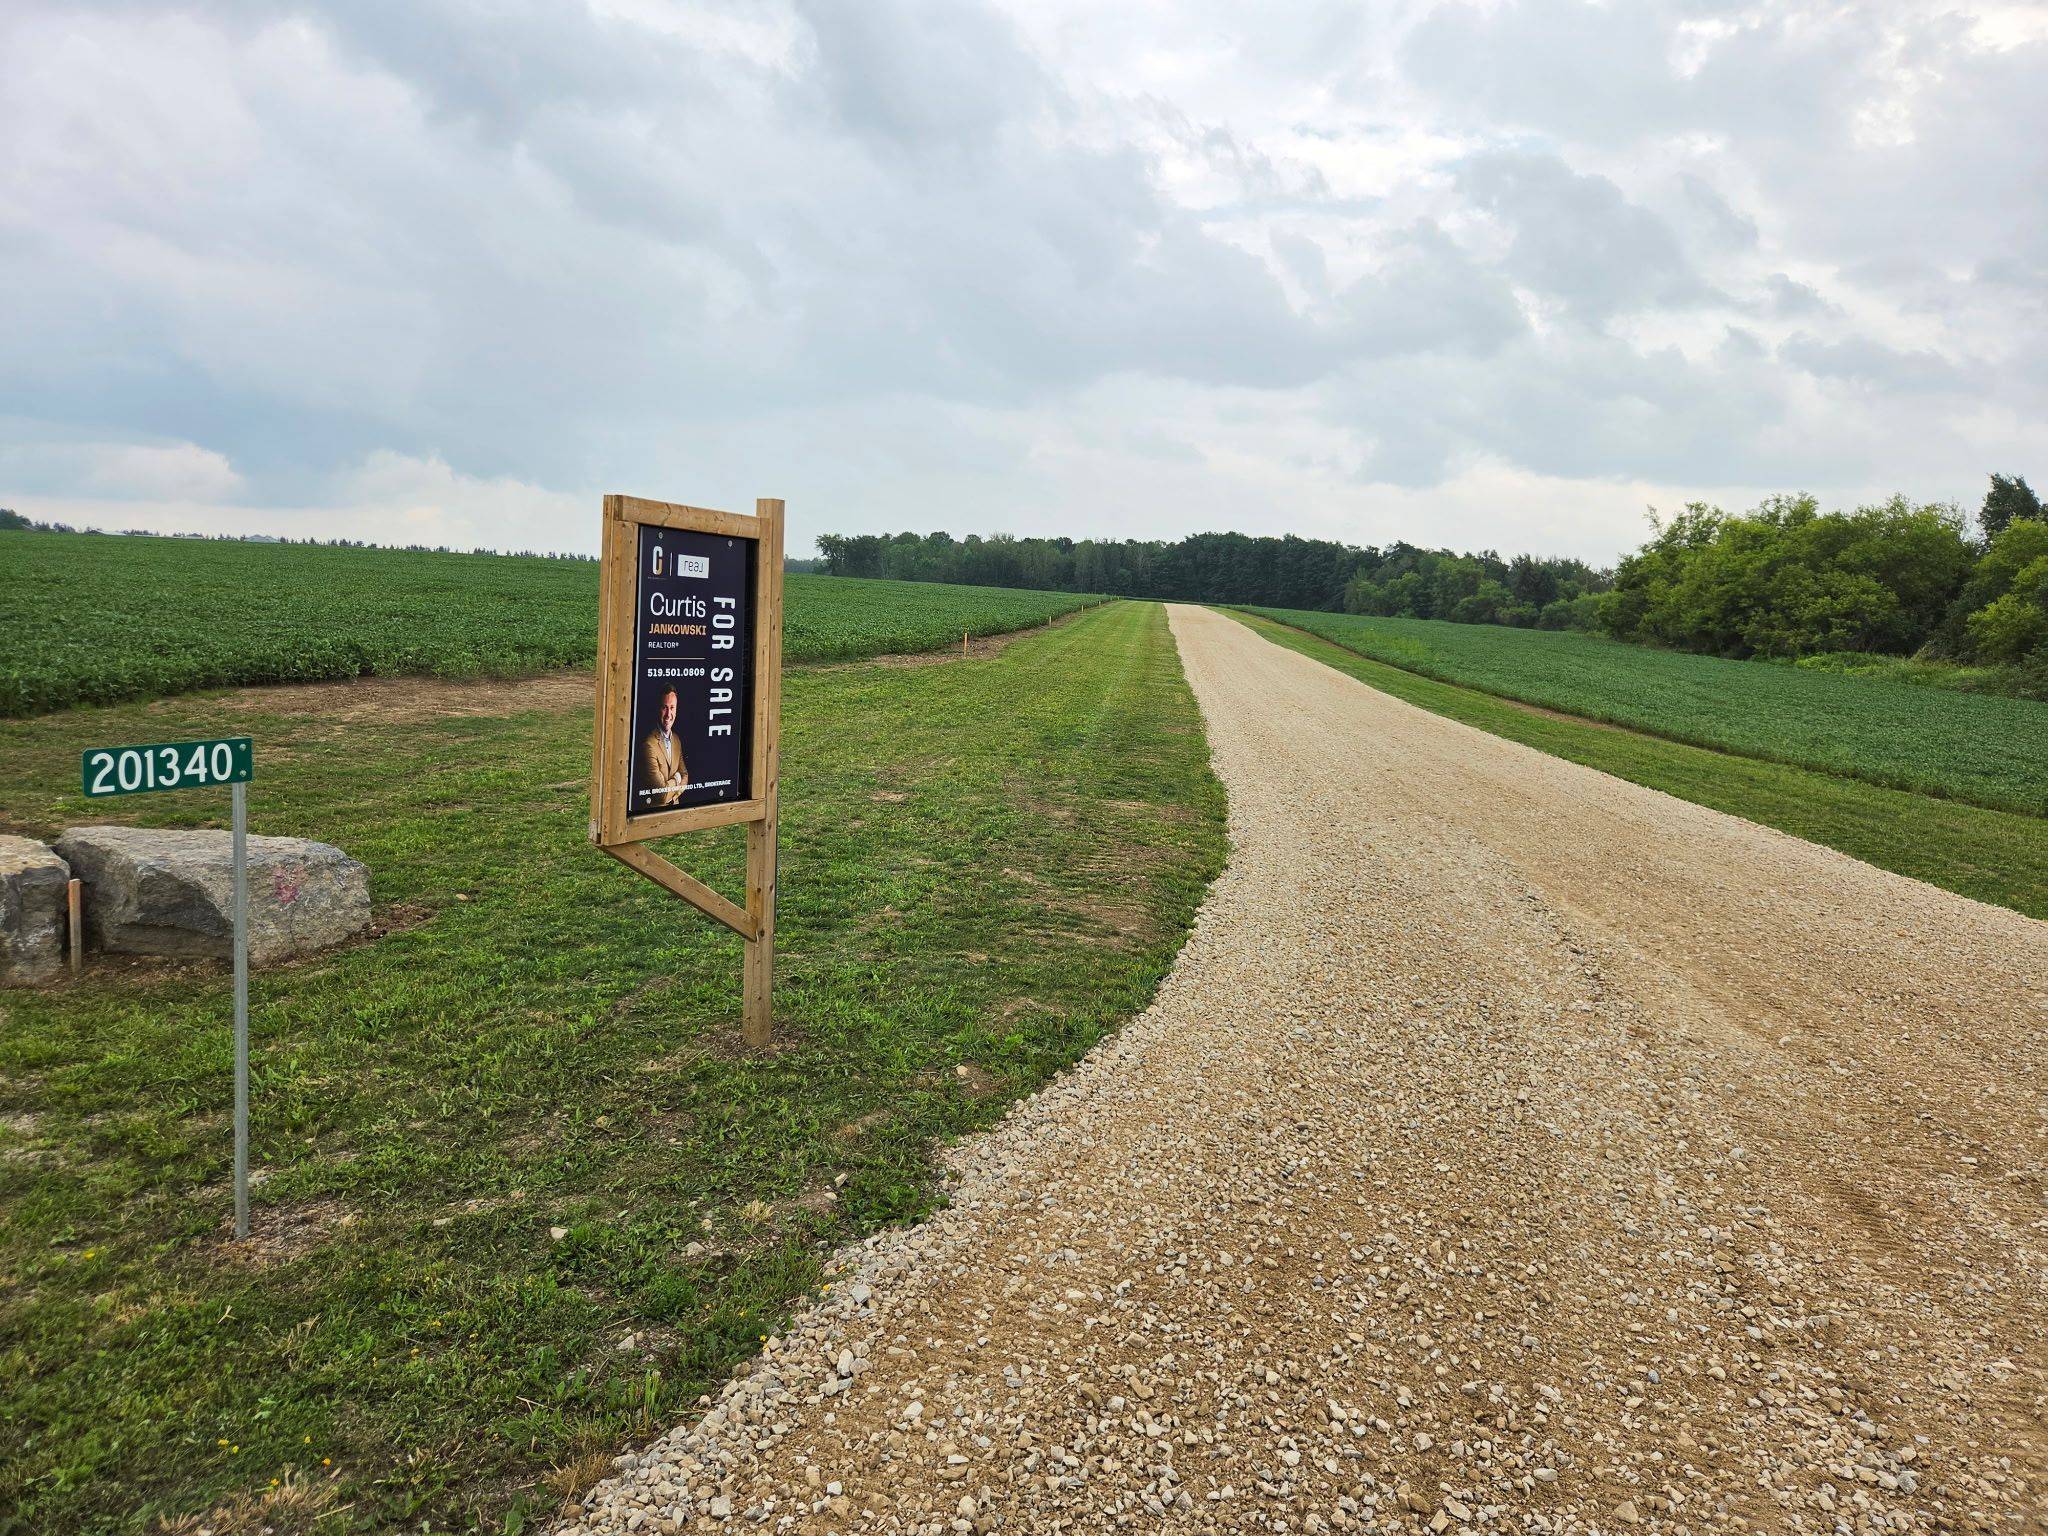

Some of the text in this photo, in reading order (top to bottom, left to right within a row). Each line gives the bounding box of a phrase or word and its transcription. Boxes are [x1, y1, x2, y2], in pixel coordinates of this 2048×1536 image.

[650, 592, 706, 618] Curtis
[649, 623, 706, 635] JANKOWSKI
[647, 668, 705, 677] 519.501.0809
[709, 597, 735, 737] FOR SALE
[91, 743, 233, 793] 201340
